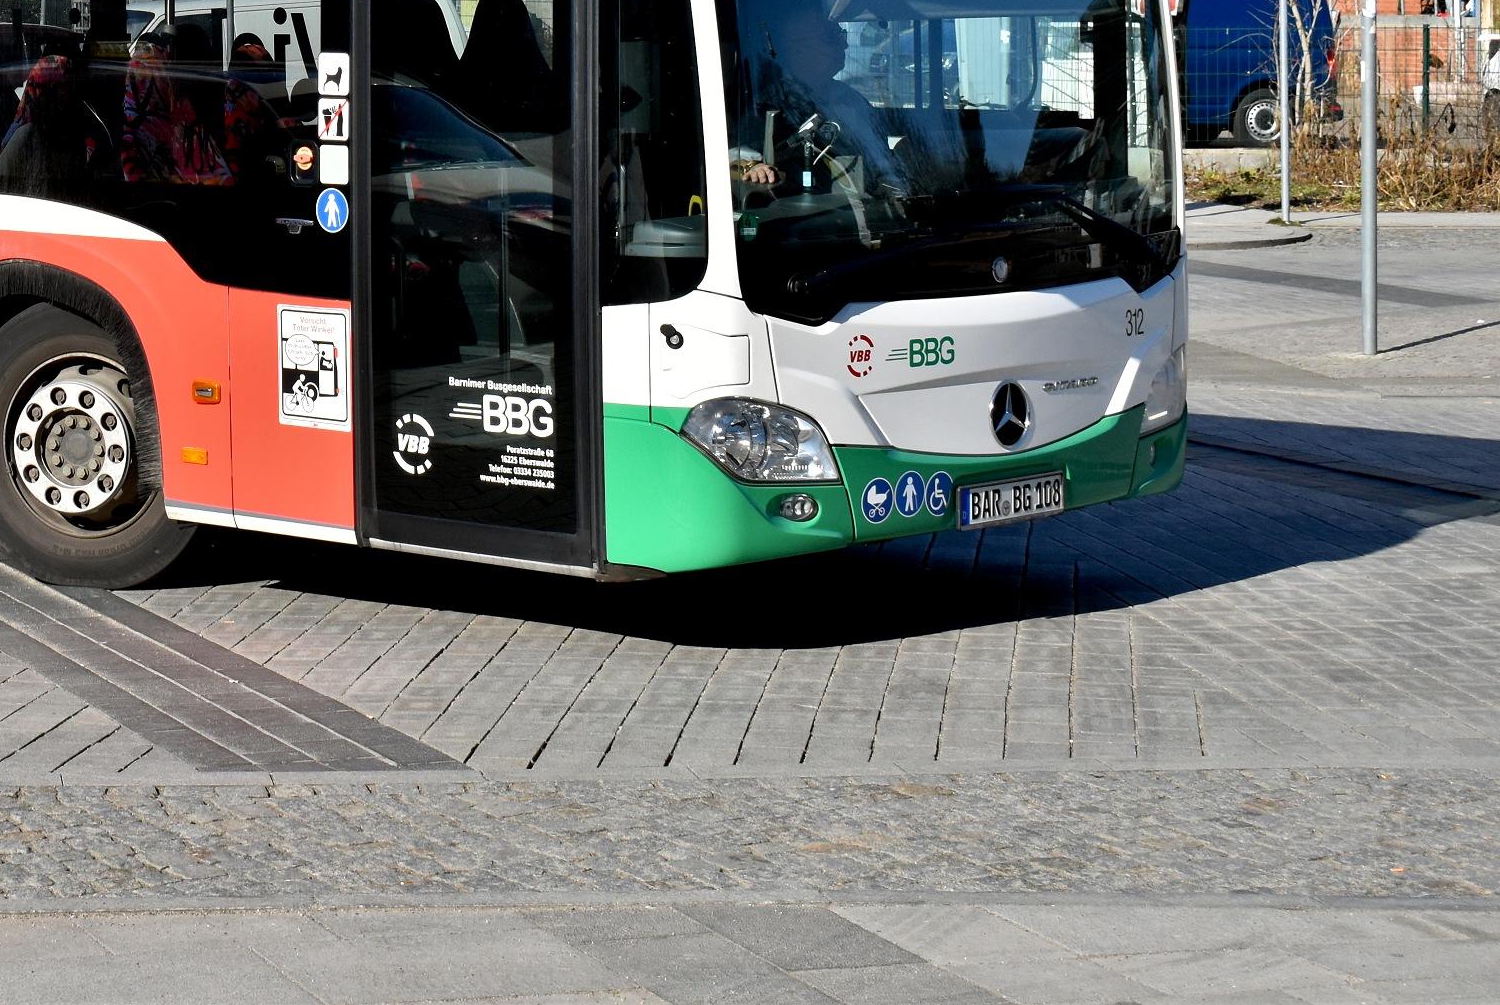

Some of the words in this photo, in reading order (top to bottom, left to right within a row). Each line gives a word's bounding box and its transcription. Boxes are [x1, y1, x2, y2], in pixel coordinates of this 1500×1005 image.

[1125, 308, 1145, 337] 312
[850, 349, 871, 363] VBB
[909, 336, 956, 367] BBG
[449, 377, 486, 390] Barnimer
[487, 380, 553, 395] Busgesellschaft
[483, 394, 554, 438] BBG
[397, 433, 431, 455] VBB
[971, 488, 1002, 520] BAR
[1012, 483, 1032, 513] BG
[1034, 478, 1061, 509] 108
